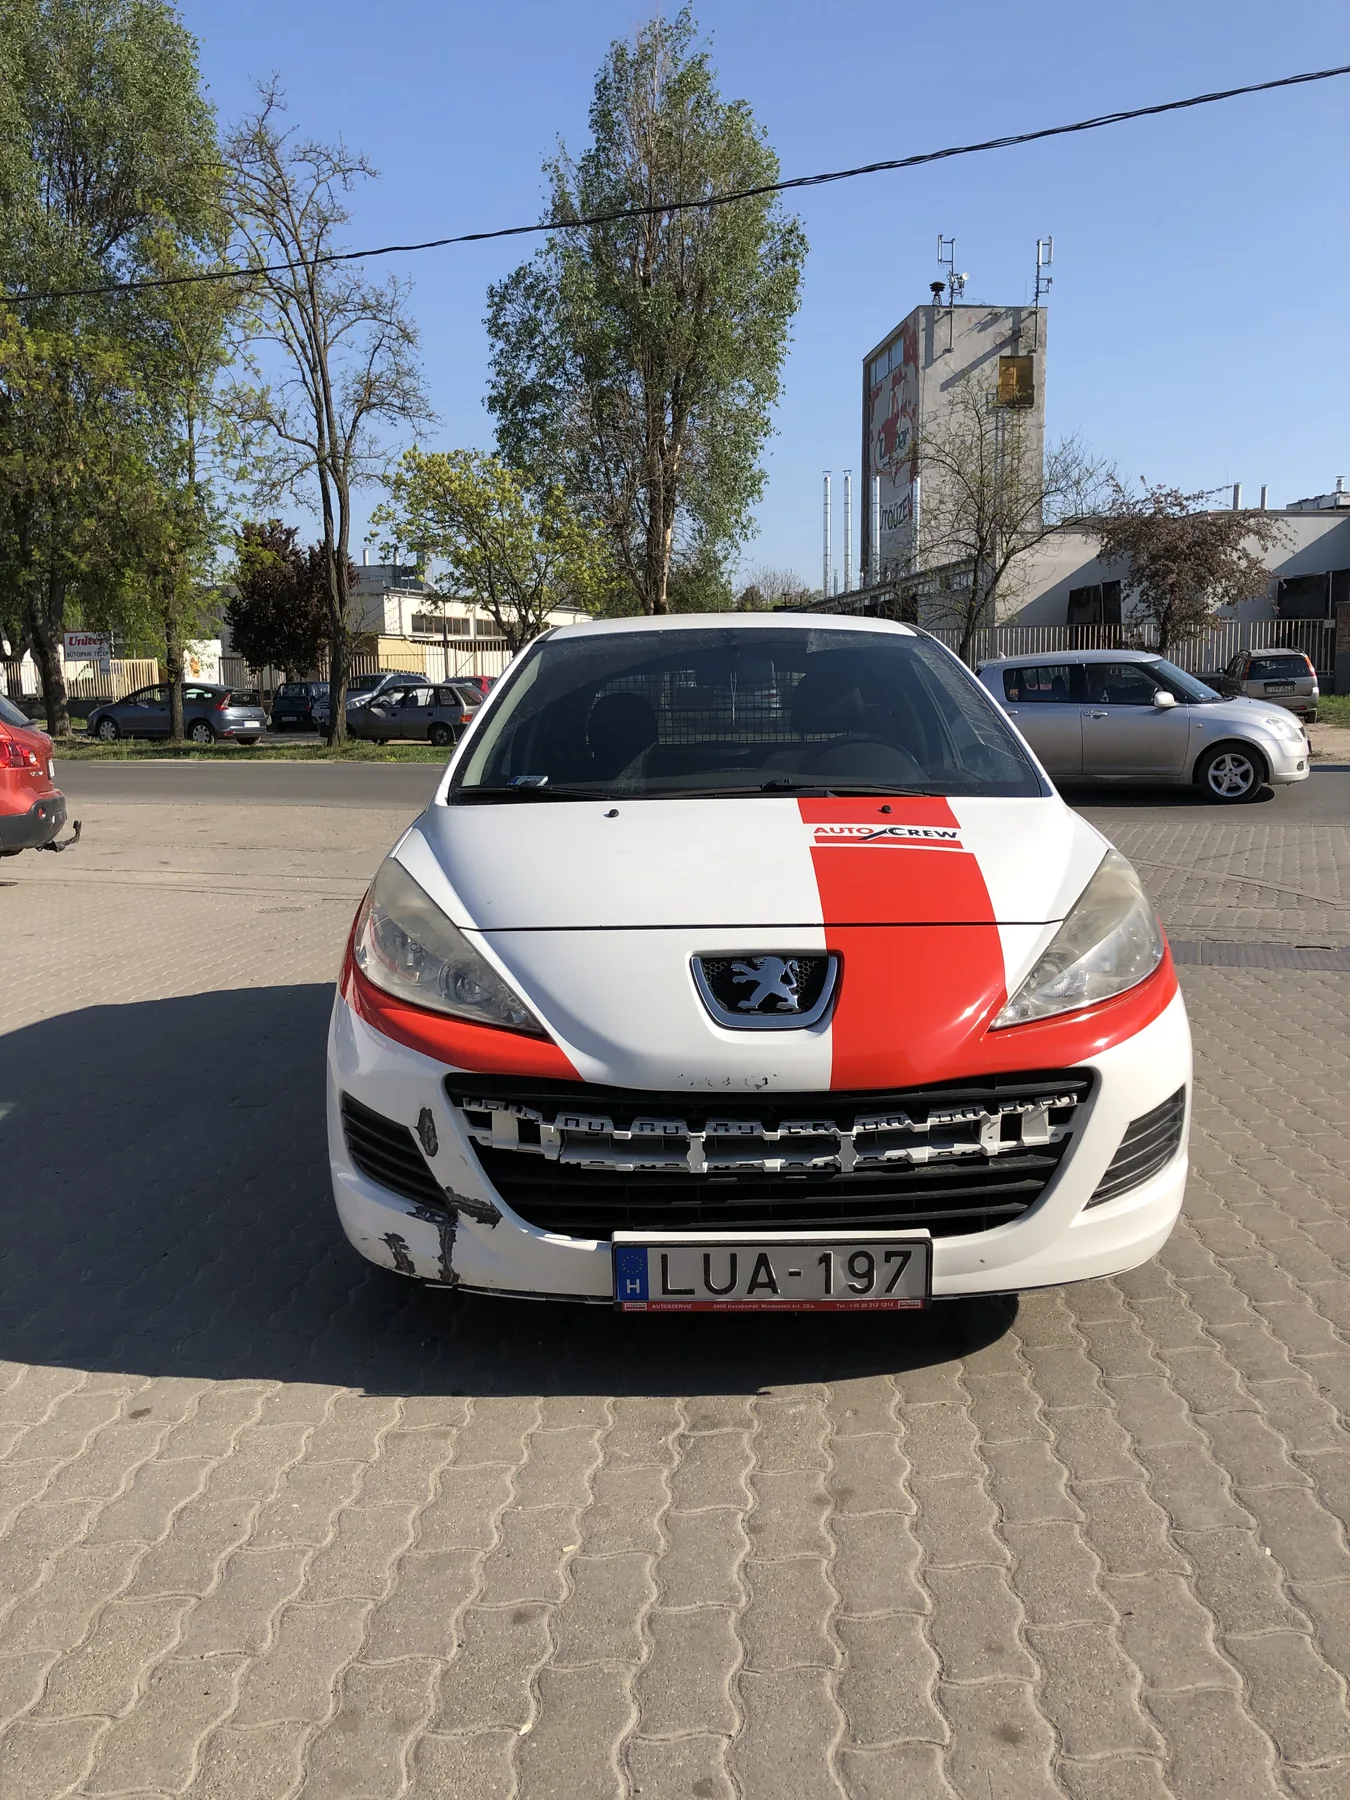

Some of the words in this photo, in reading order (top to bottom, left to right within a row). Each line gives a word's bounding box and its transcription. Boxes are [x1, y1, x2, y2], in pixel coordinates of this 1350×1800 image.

[813, 827, 874, 835] AUTO
[887, 827, 957, 839] CREW
[660, 1250, 912, 1295] LUA-197
[626, 1279, 641, 1294] H
